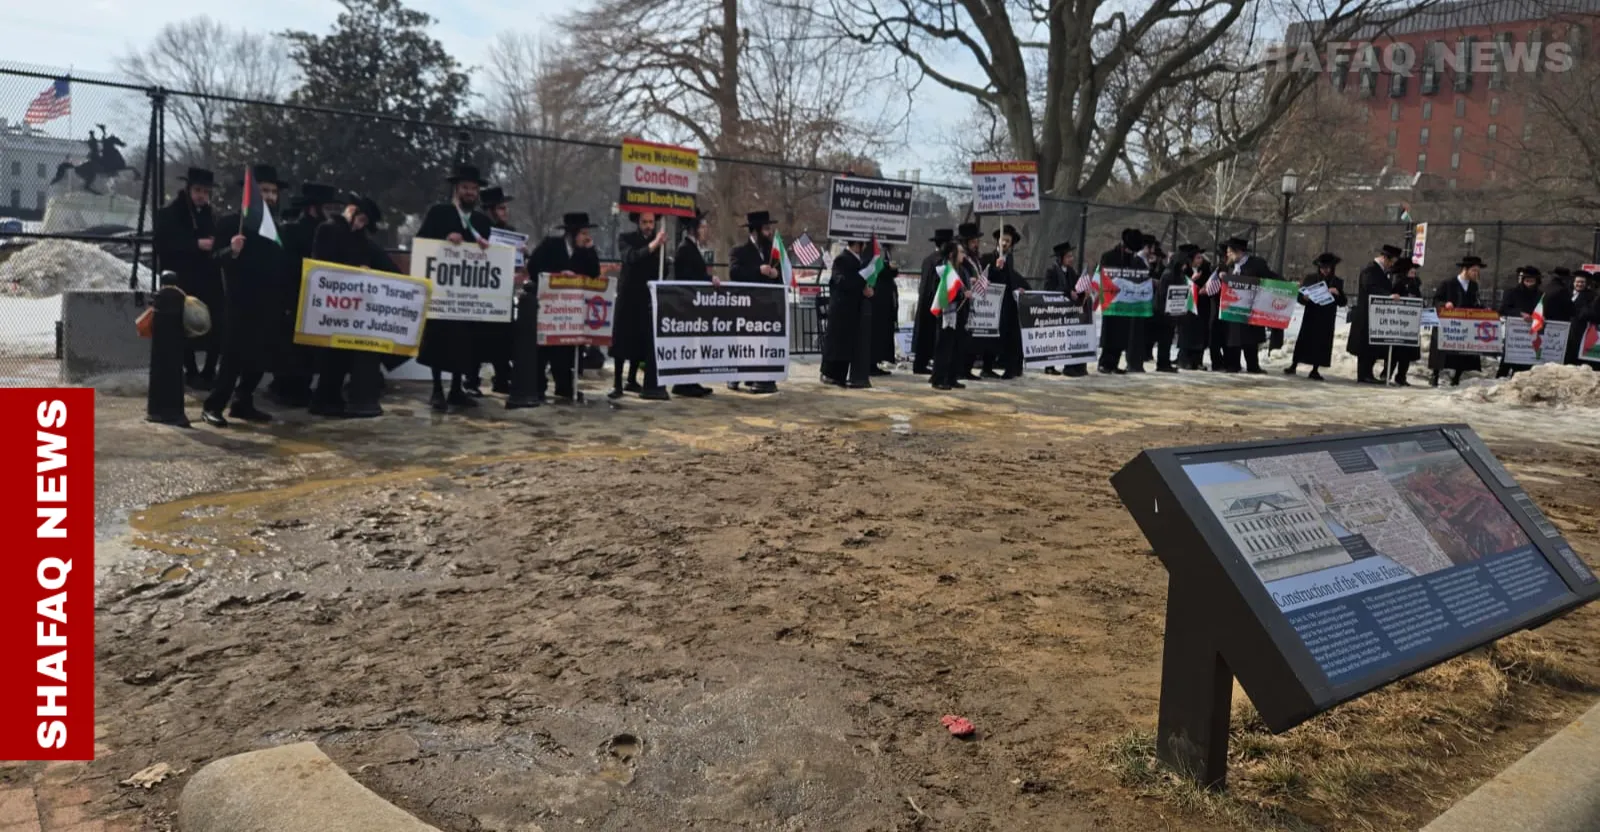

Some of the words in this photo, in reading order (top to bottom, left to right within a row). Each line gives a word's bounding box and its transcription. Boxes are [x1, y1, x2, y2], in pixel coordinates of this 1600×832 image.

[635, 165, 688, 188] Condemn
[836, 183, 891, 198] Netanyahu
[893, 188, 902, 198] is
[977, 184, 997, 192] State
[998, 183, 1006, 191] of
[979, 191, 1006, 200] "Israel"
[840, 197, 861, 209] War
[862, 200, 904, 212] Criminal
[978, 202, 993, 210] And
[444, 248, 460, 258] The
[462, 249, 488, 260] Torah
[426, 256, 502, 289] Forbids
[318, 277, 364, 294] Support
[368, 283, 378, 294] to
[382, 284, 420, 300] "Israel"
[692, 290, 752, 307] Judaism
[312, 294, 322, 308] is
[325, 295, 362, 311] NOT
[366, 302, 419, 322] supporting
[544, 304, 582, 314] Zionism
[318, 314, 350, 328] Jews
[352, 319, 365, 329] or
[367, 318, 408, 336] Judaism
[536, 322, 556, 331] State
[559, 322, 566, 330] of
[661, 317, 709, 332] Stands
[712, 317, 733, 332] for
[736, 317, 782, 332] Peace
[1034, 317, 1062, 328] Against
[1064, 316, 1080, 324] Iran
[1379, 318, 1388, 326] Lift
[1028, 332, 1034, 340] Is
[1035, 330, 1047, 339] Part
[1048, 330, 1056, 338] of
[1066, 328, 1087, 336] Crimes
[1443, 334, 1468, 342] "Israel"
[657, 346, 677, 361] Not
[681, 346, 697, 360] for
[700, 344, 724, 359] War
[728, 344, 756, 358] With
[760, 344, 786, 358] Iran
[1031, 344, 1058, 354] Violation
[1272, 582, 1333, 608] Construction
[1332, 576, 1343, 593] of
[1342, 575, 1360, 589] the
[1355, 568, 1382, 586] White
[1378, 564, 1410, 581] House
